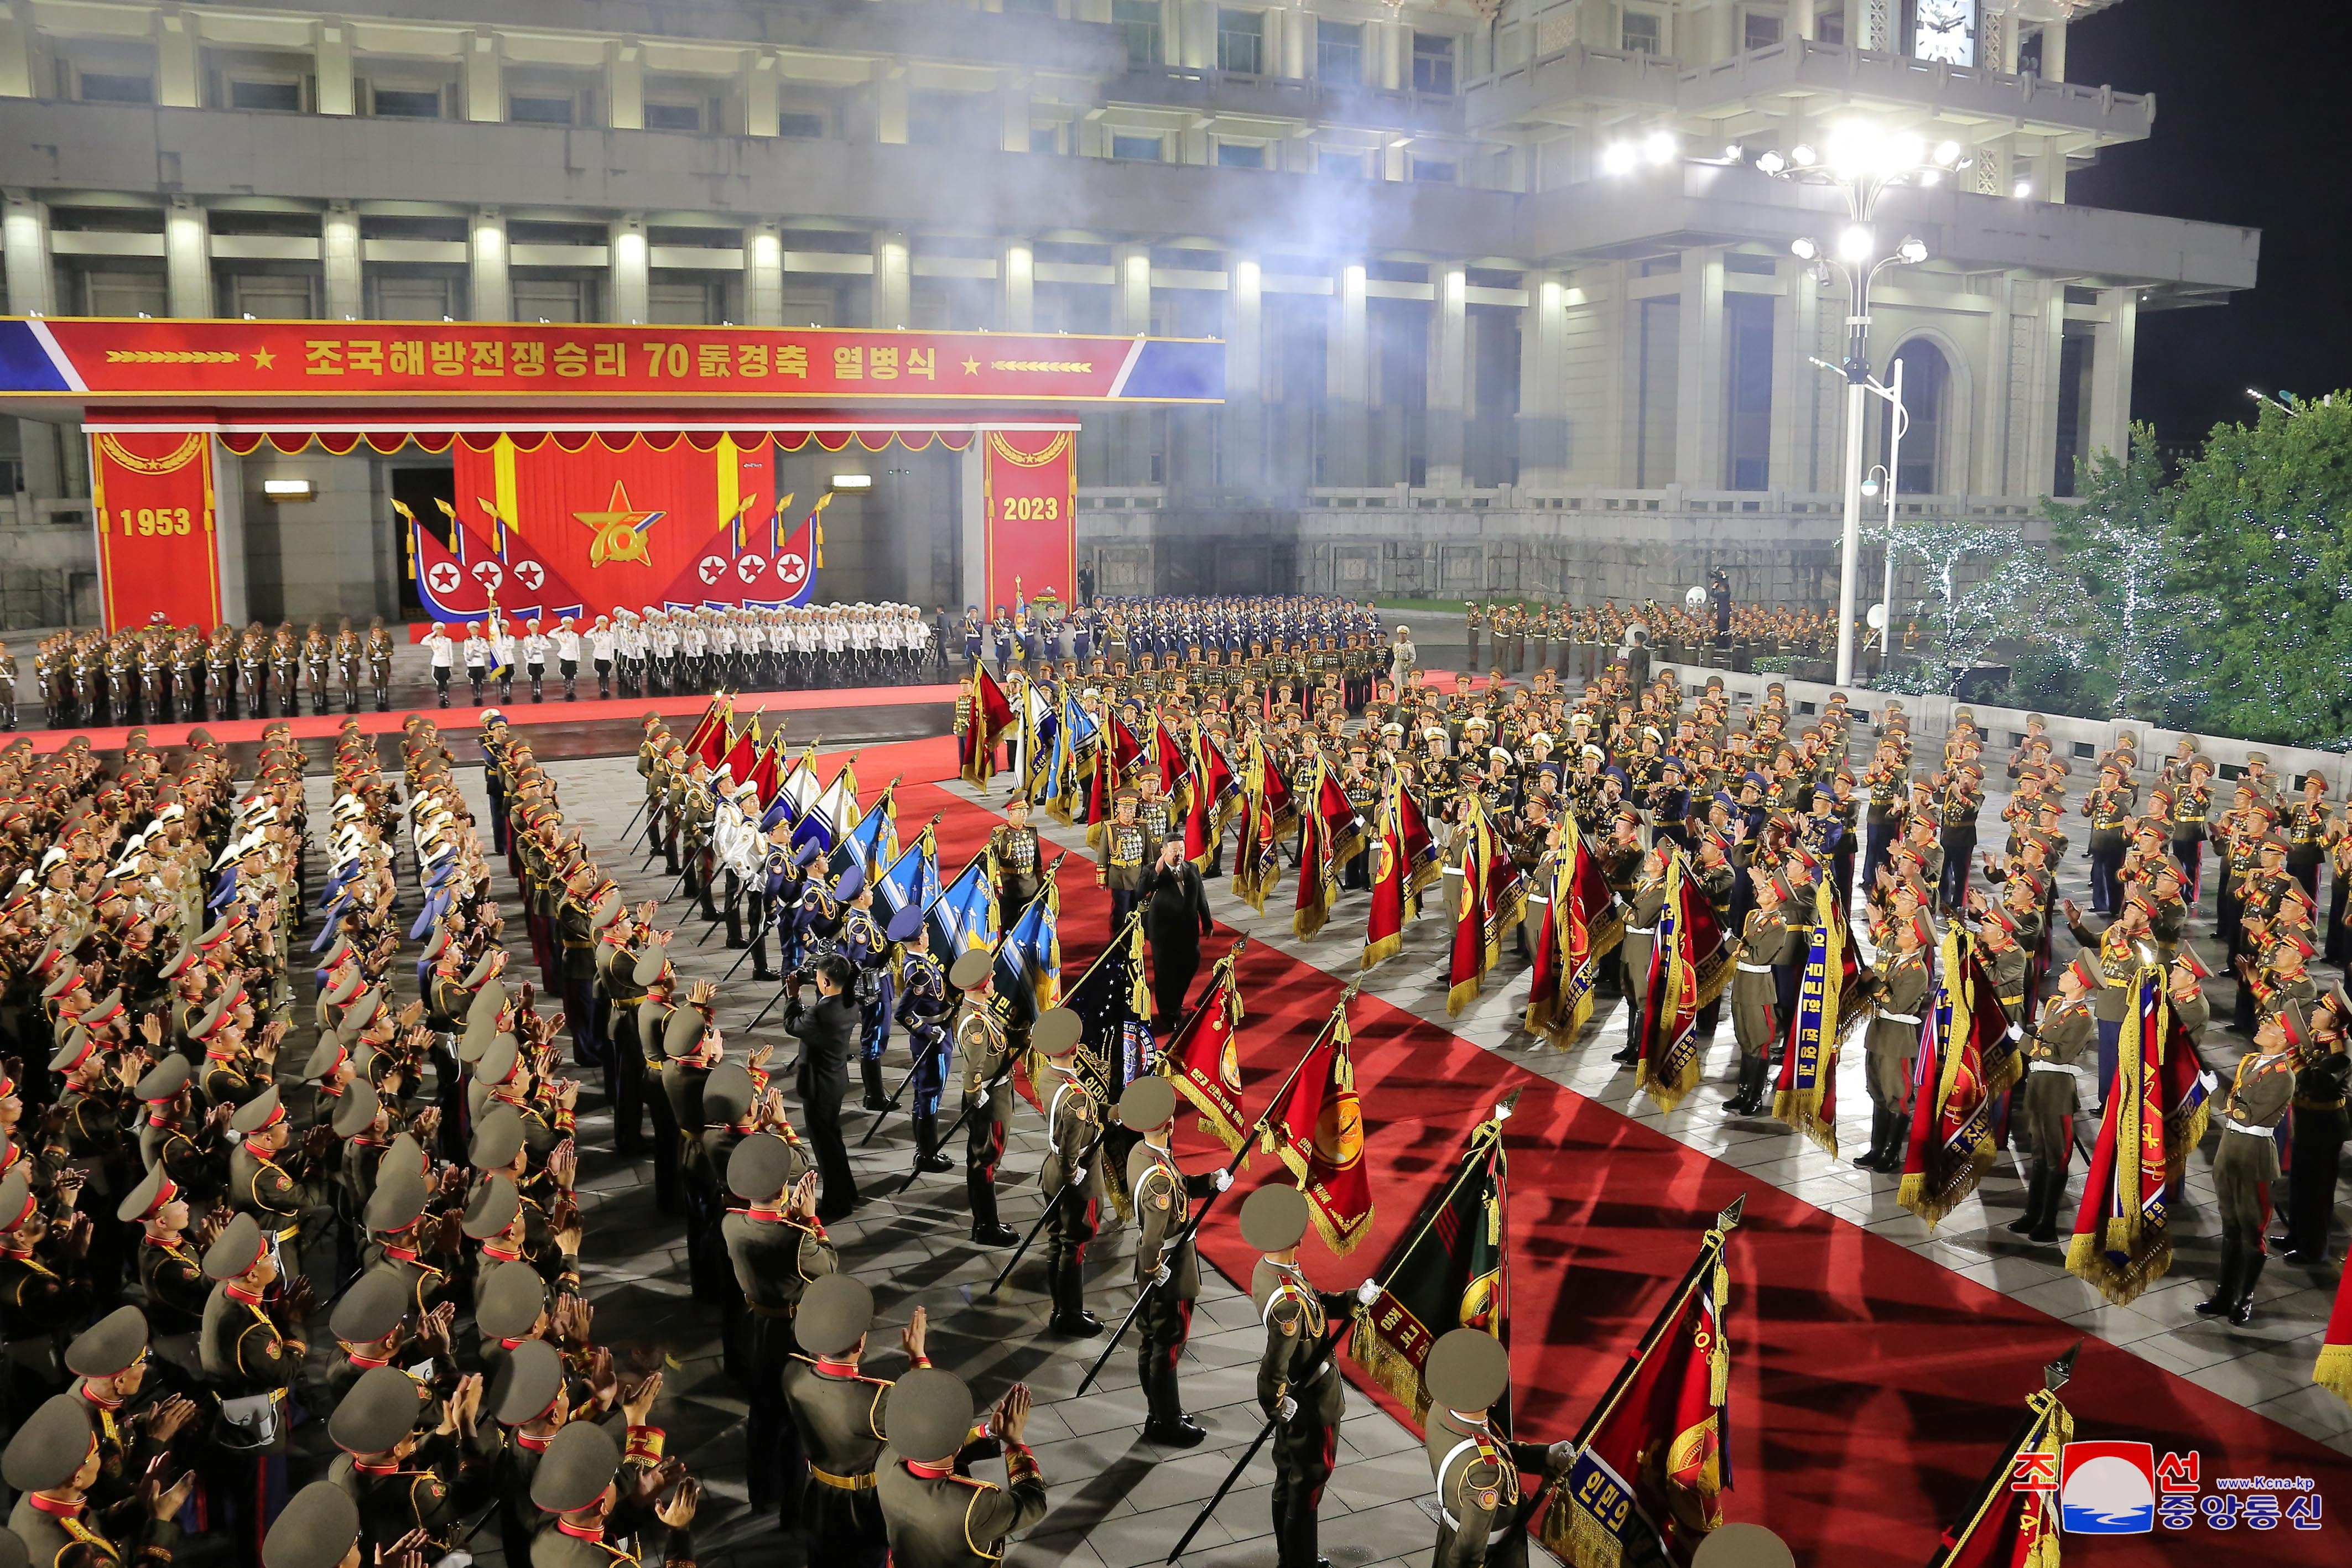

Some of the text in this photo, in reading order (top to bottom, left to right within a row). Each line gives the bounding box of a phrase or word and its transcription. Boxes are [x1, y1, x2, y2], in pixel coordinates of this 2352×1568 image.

[305, 340, 626, 377] 조국해방전쟁승리
[833, 346, 935, 380] 열병식
[119, 507, 191, 536] 1953
[1003, 496, 1058, 520] 2023
[1497, 883, 1525, 914] 91군단
[1803, 963, 1824, 1013] 무궁한
[1798, 1028, 1819, 1076] 번영과
[1579, 1471, 1630, 1533] 인민의
